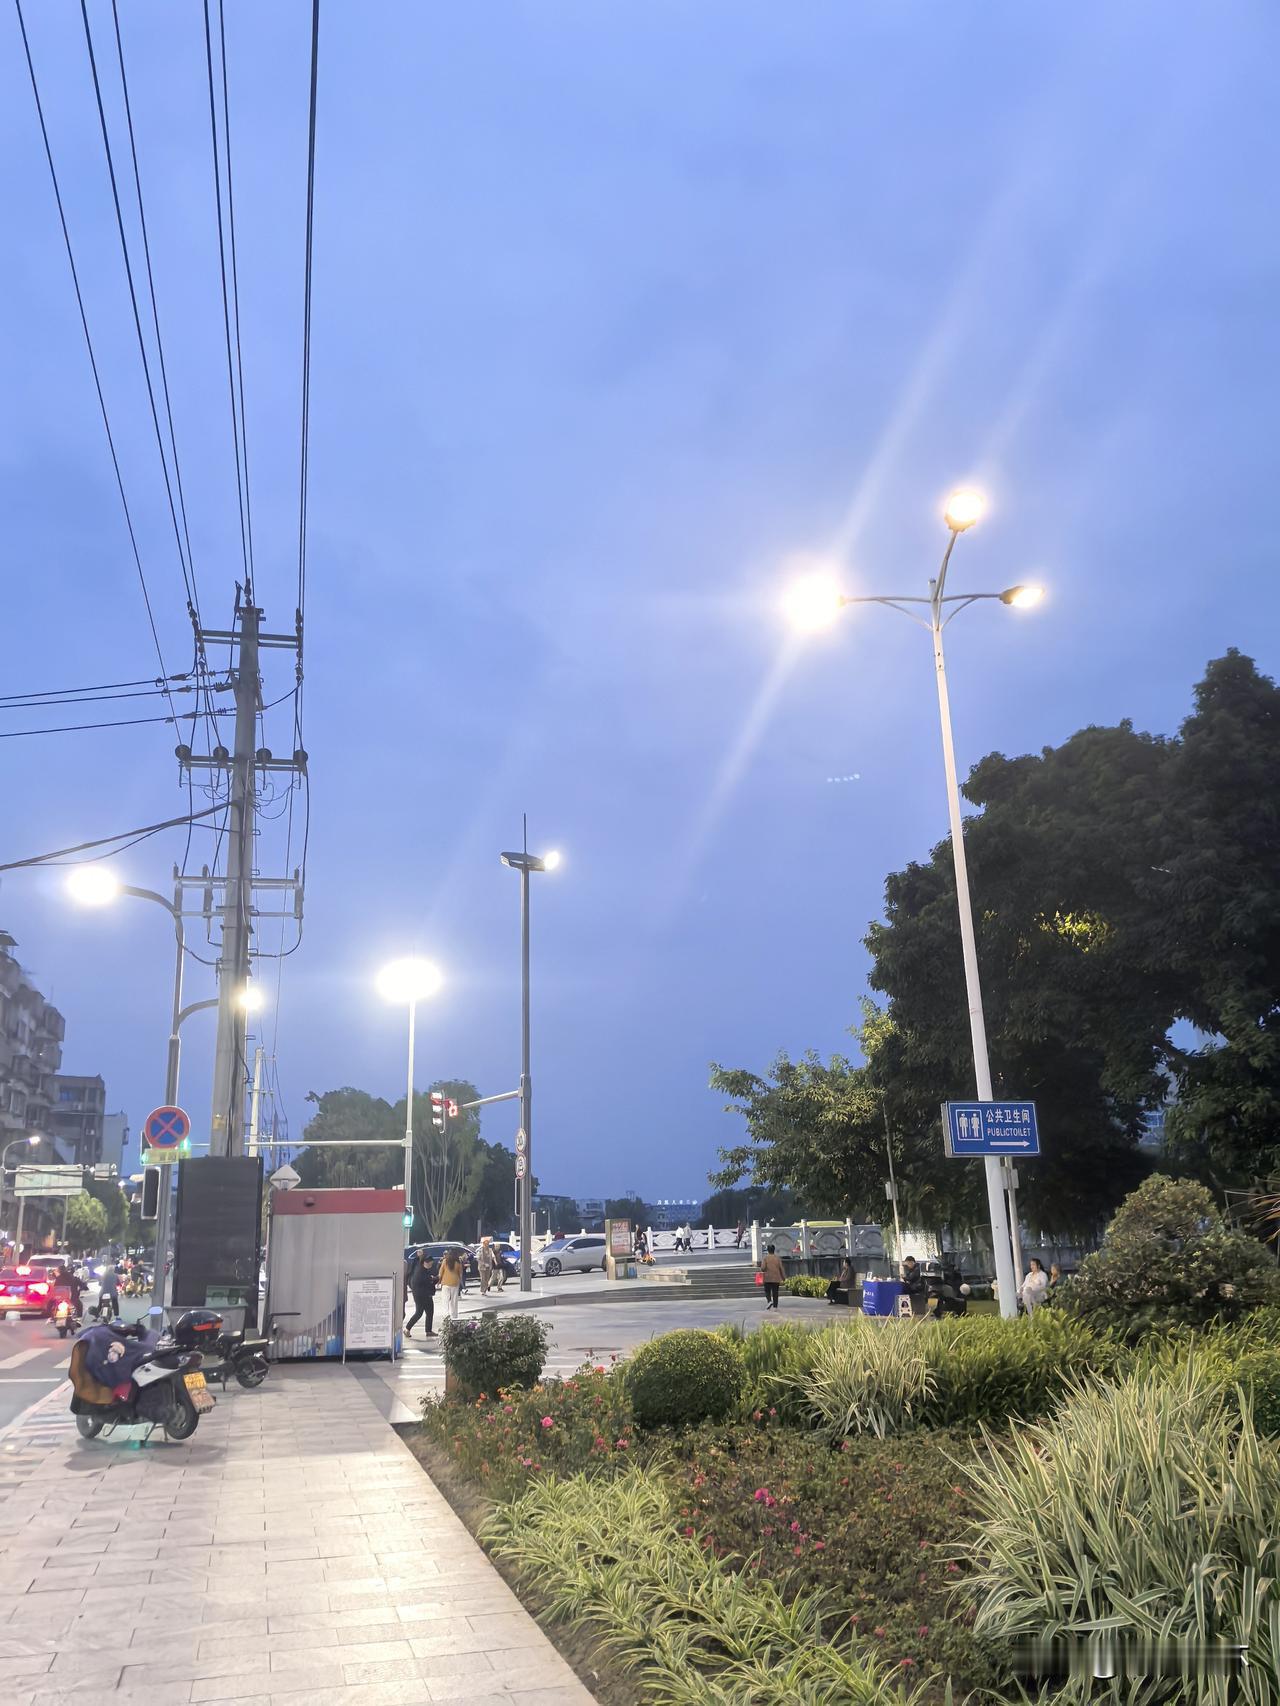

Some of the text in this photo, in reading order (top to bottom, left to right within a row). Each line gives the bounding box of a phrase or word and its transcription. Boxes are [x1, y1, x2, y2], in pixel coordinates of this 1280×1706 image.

[985, 1108, 1030, 1123] 公共卫生间
[987, 1127, 1031, 1137] PUBLICTOILET
